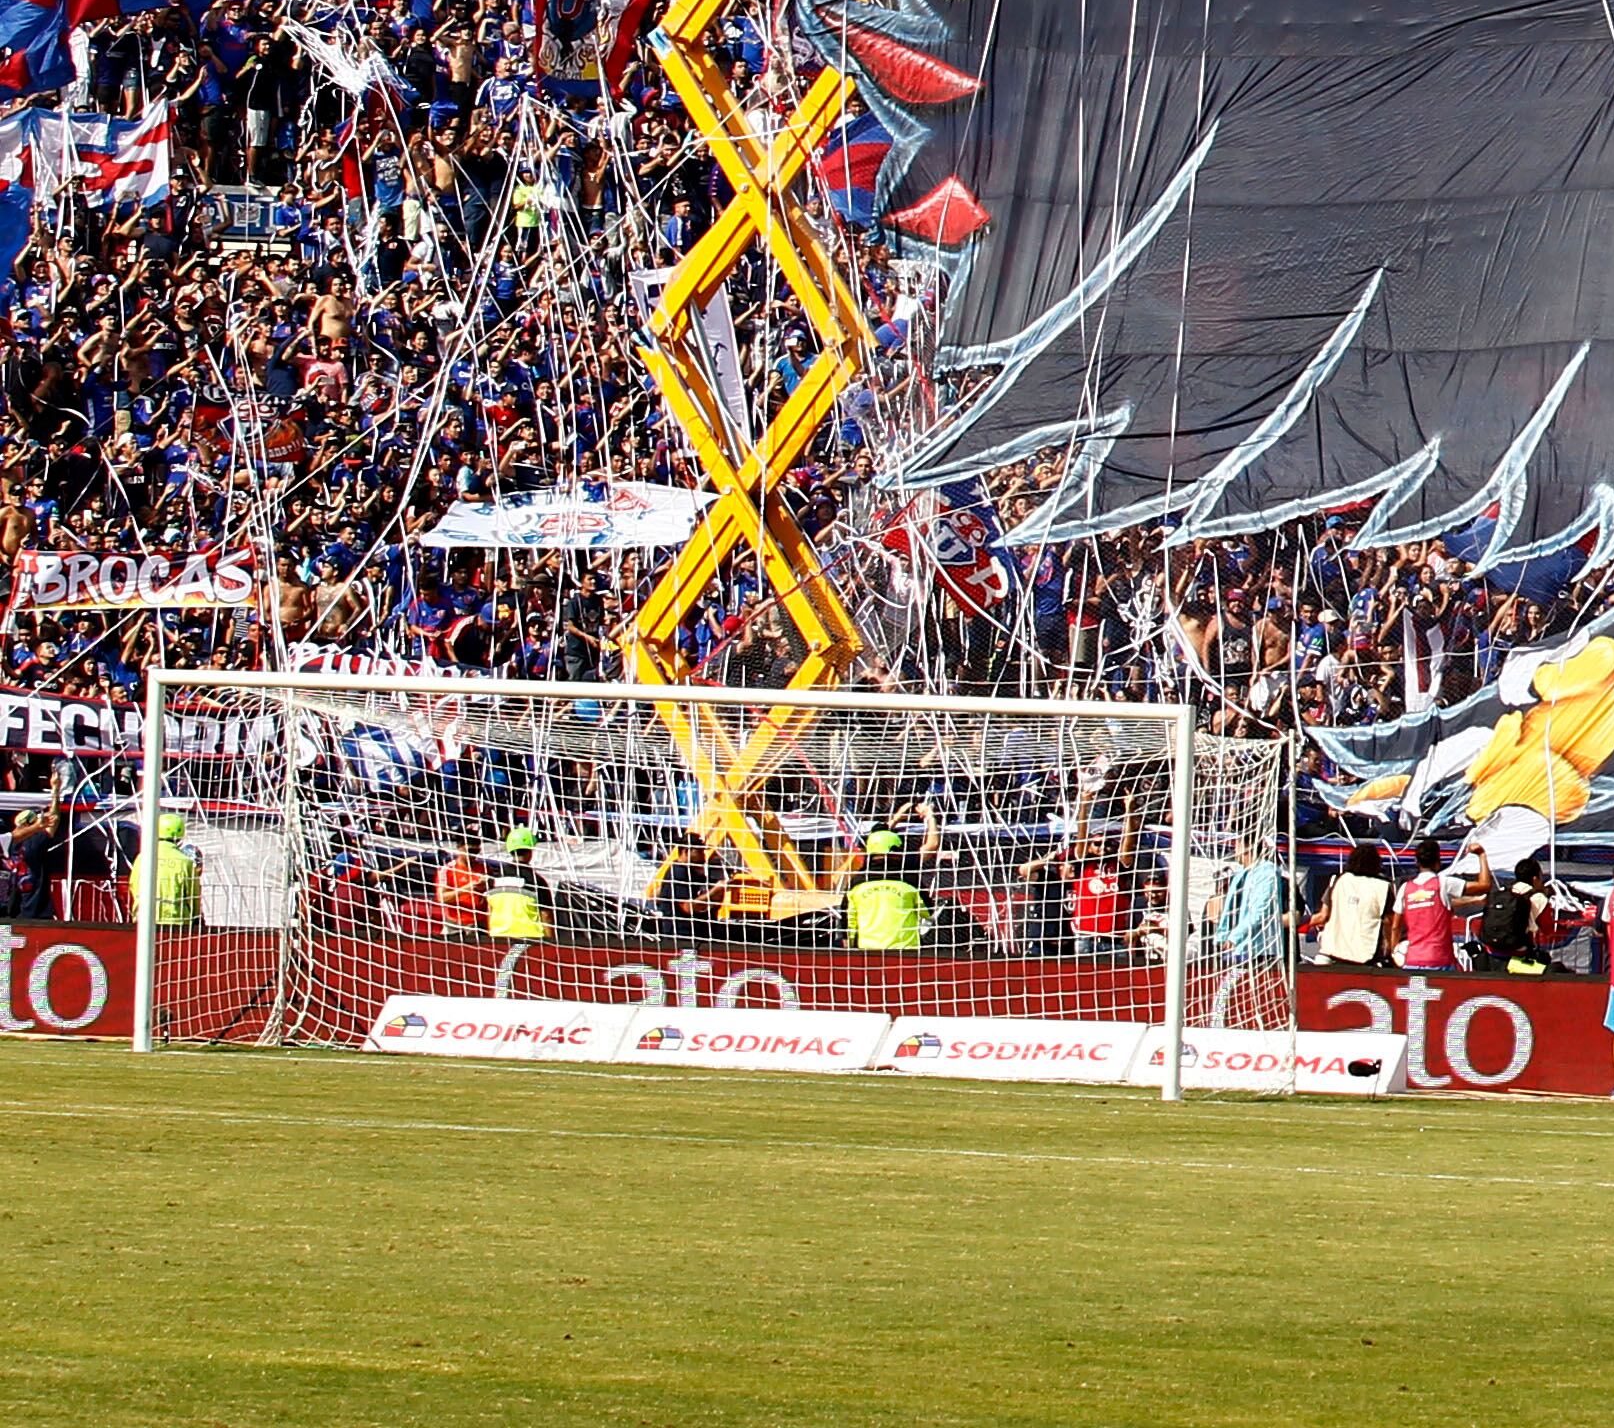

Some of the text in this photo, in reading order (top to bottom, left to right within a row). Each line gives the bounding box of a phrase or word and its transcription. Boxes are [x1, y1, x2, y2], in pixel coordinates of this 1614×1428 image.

[35, 546, 258, 606] BROCAS
[430, 1021, 593, 1046] SODIMAC
[689, 1033, 854, 1057] SODIMAC
[947, 1040, 1113, 1063] SODIMAC
